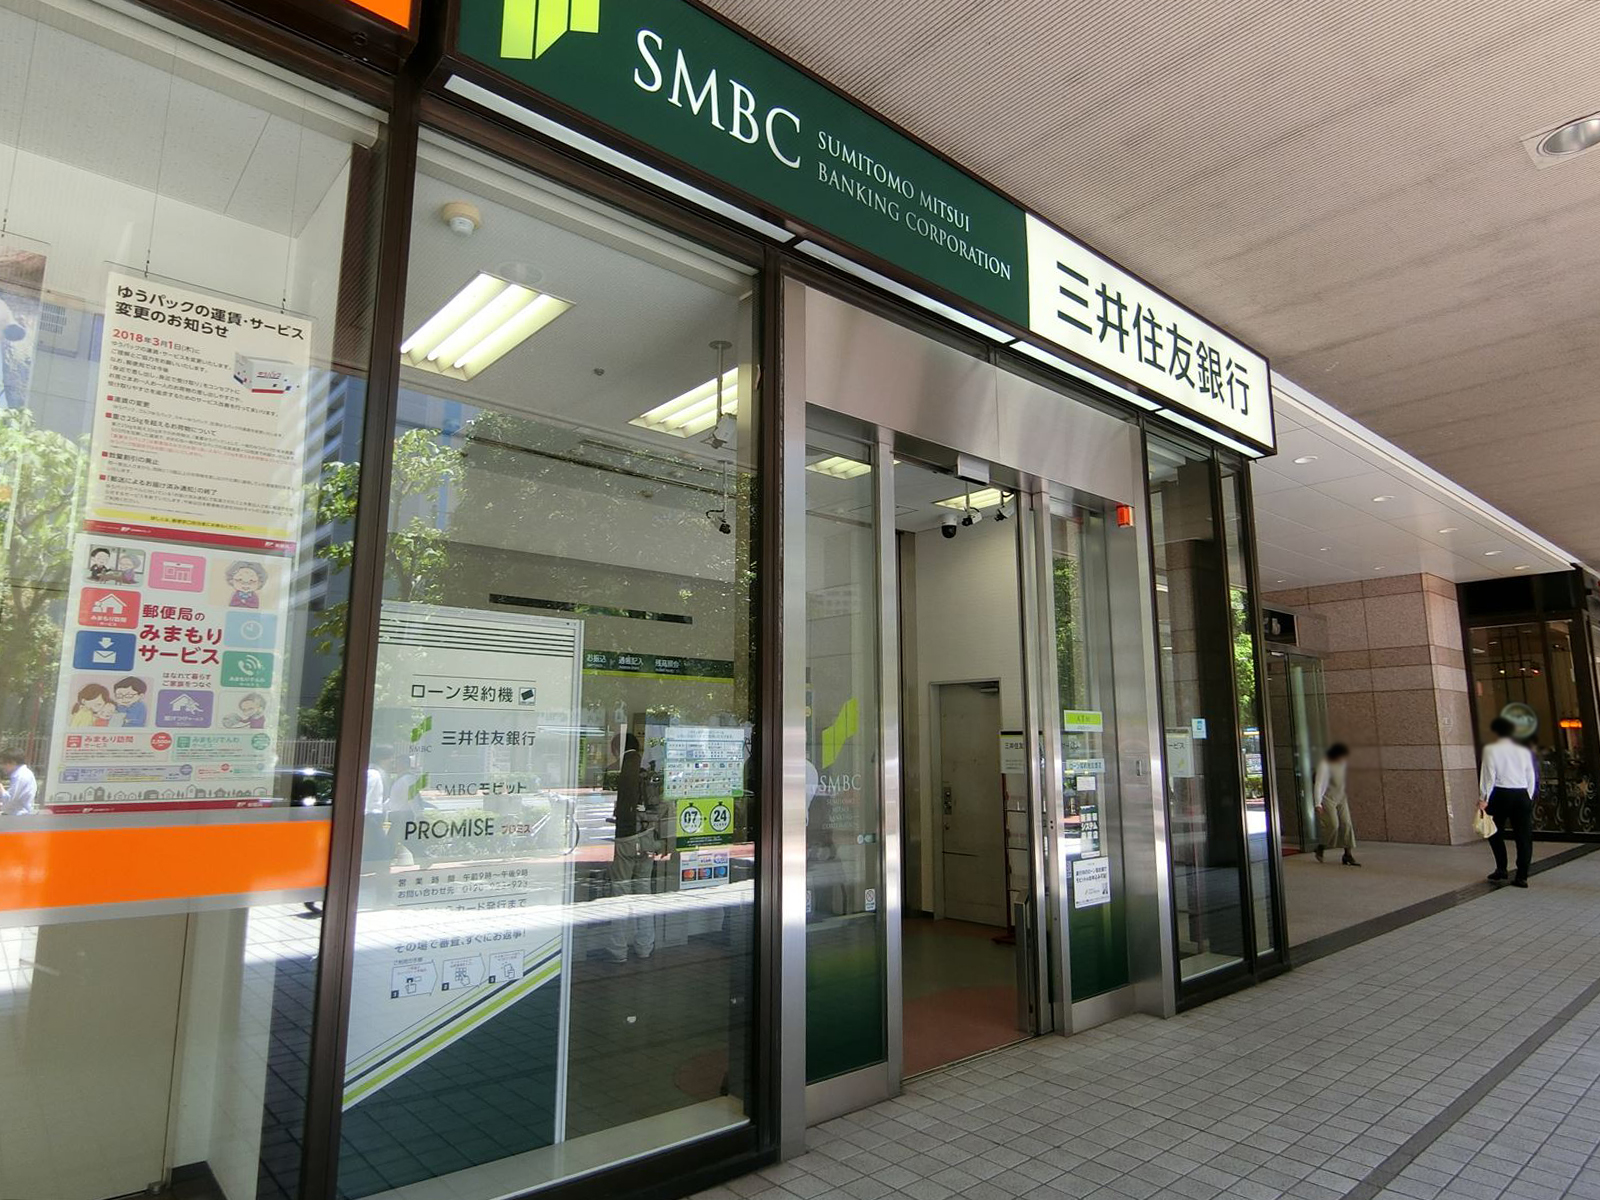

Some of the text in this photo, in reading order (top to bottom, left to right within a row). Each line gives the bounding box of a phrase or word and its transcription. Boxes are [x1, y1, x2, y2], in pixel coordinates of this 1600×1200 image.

[633, 28, 800, 169] SMBC
[818, 131, 970, 233] SUMITOMO MITSUI
[818, 162, 1012, 281] BANKING CORPORATION
[115, 301, 229, 338] 変更のお知らせ
[117, 285, 304, 340] ゆうパックの運賃・サービス
[1056, 260, 1249, 415] 三井住友銀行
[142, 604, 205, 621] 郵便局の
[139, 624, 222, 645] みまもり
[138, 645, 221, 665] サービス
[162, 672, 212, 680] はなれて暮らす
[162, 680, 212, 688] ご家族をつなぐ
[411, 684, 513, 703] ローン契約機
[84, 735, 134, 743] みまもり訪問
[441, 730, 536, 746] 三井住友銀行
[819, 773, 861, 791] SMBC
[684, 810, 698, 824] 07
[713, 809, 727, 822] 24
[404, 818, 531, 840] PROMISE プロミス
[397, 886, 455, 898] お問い合わせ先
